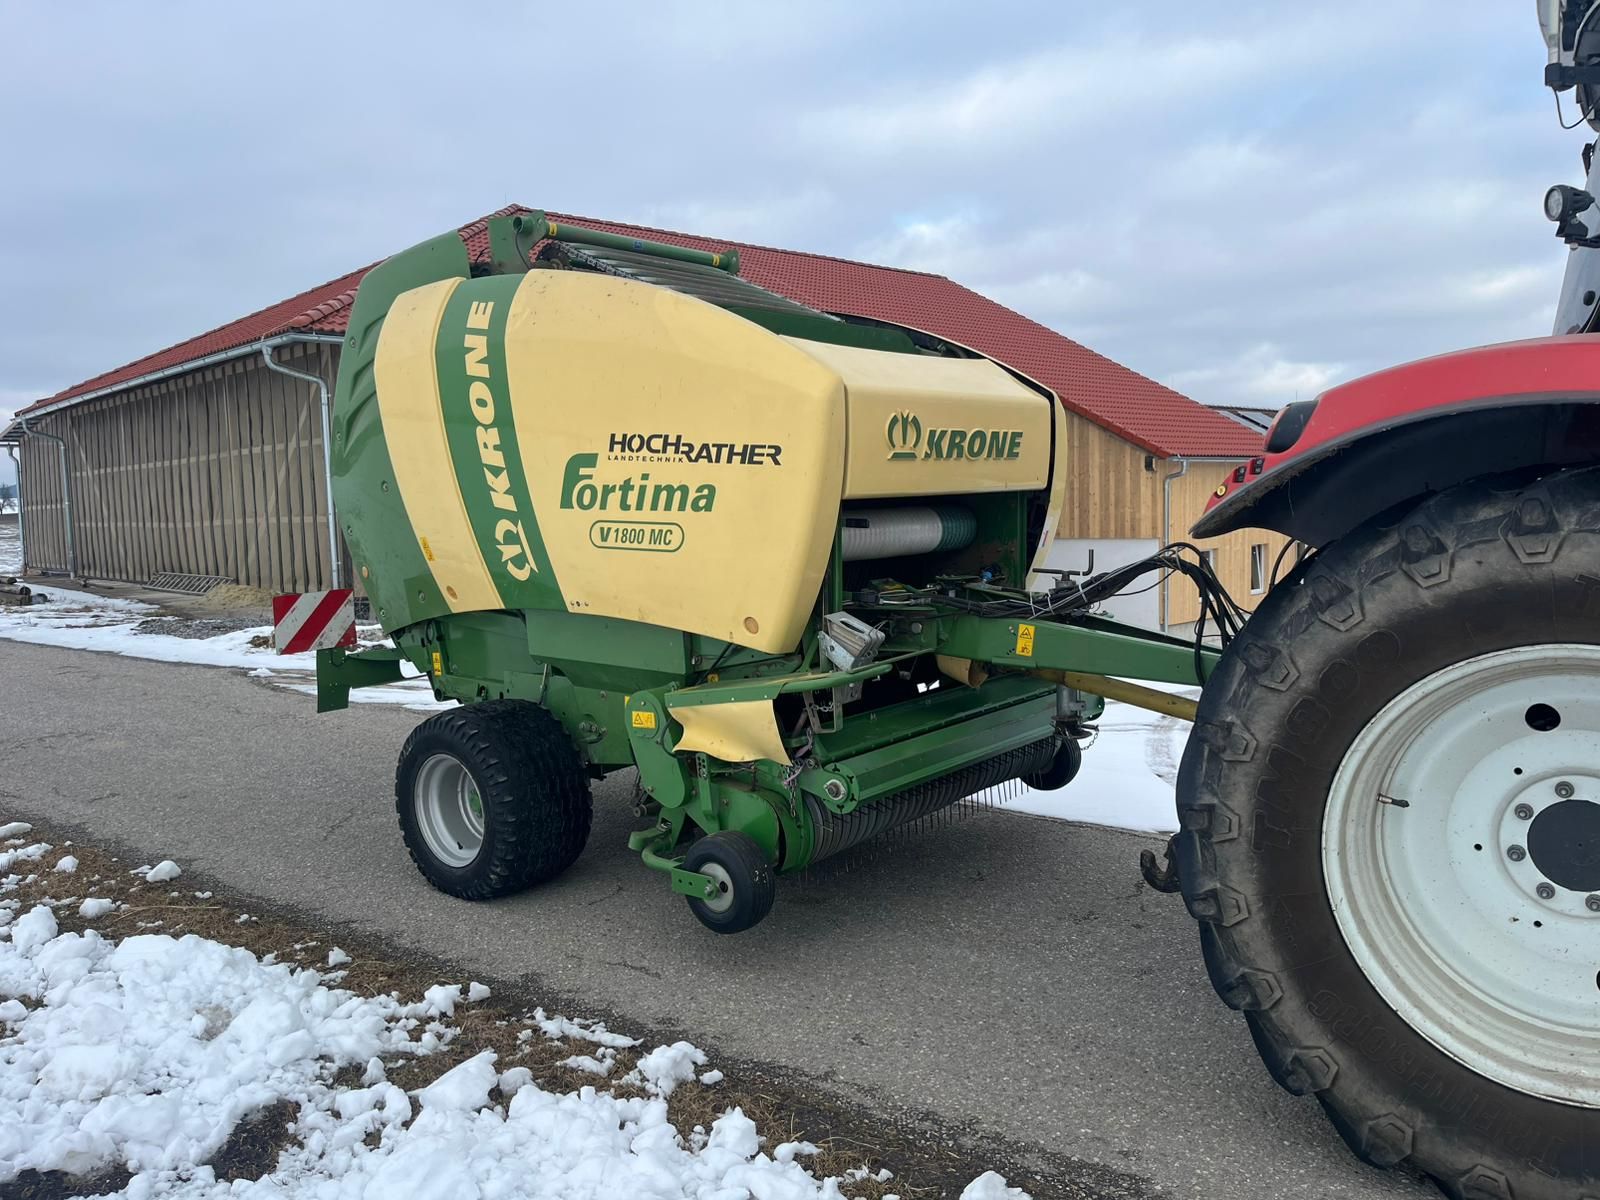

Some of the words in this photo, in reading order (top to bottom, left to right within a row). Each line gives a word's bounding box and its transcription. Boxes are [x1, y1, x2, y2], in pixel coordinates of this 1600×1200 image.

[464, 301, 518, 512] KRONE
[607, 455, 684, 463] LANDTECHNIK
[608, 433, 782, 466] HOCHRATHER
[923, 429, 1023, 459] KRONE
[560, 453, 717, 512] Fortima
[649, 529, 673, 545] MC
